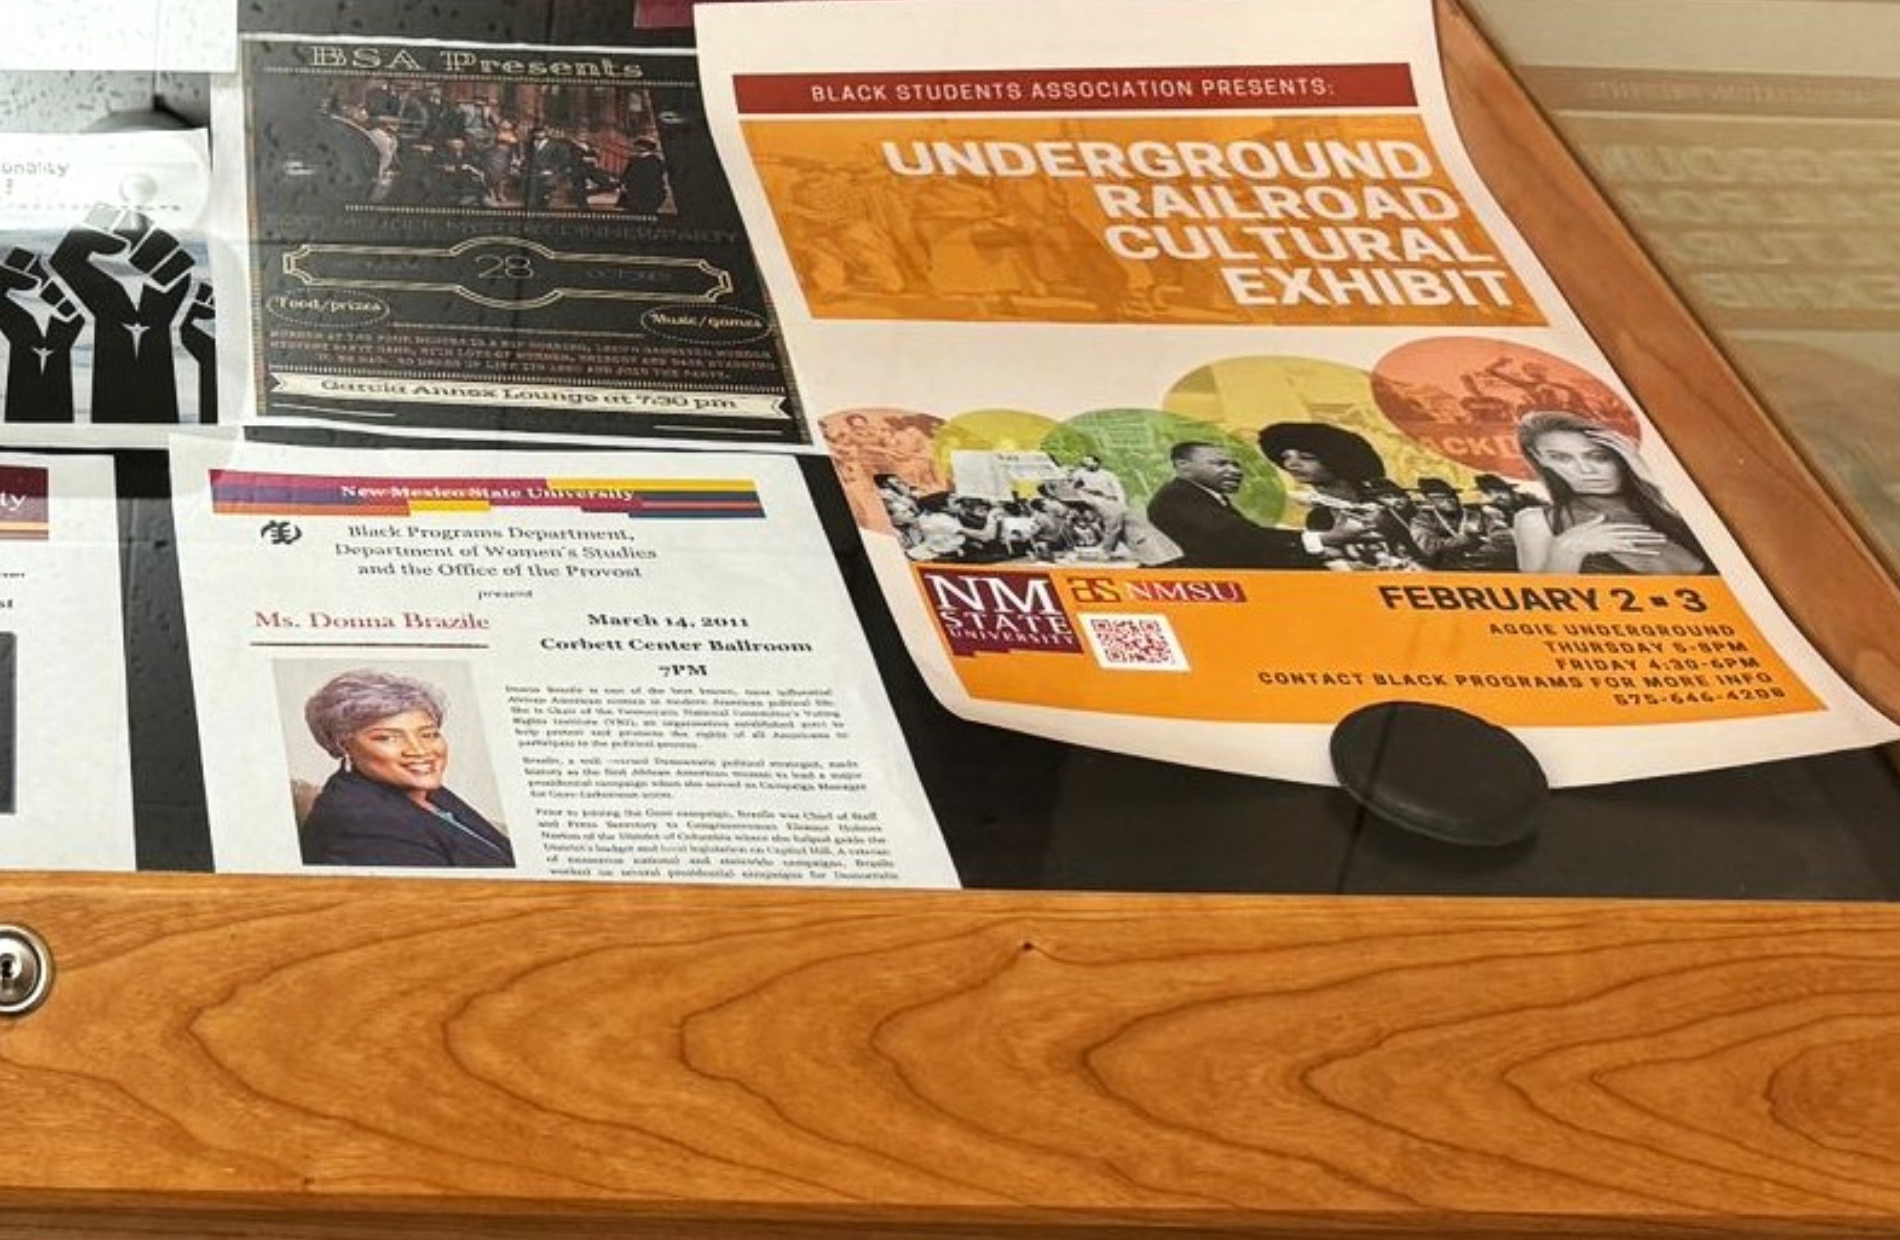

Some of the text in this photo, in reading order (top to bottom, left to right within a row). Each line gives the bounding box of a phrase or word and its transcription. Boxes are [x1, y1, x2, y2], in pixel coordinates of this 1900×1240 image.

[310, 47, 643, 79] BSA Presents
[811, 77, 1336, 103] BLACK STUDENTS ASSOCIATION PRESENTS:
[880, 140, 1434, 180] UNDERGROUND
[1094, 184, 1460, 222] RAILROAD
[1103, 224, 1498, 263] CULTURAL
[476, 256, 535, 282] 28
[1219, 267, 1514, 308] EXHIBIT
[414, 384, 494, 398] Annex
[502, 388, 592, 405] Lounge
[693, 398, 738, 413] pm
[348, 526, 635, 543] Black Programs Department,
[335, 545, 452, 559] Department
[459, 546, 478, 558] of
[583, 546, 656, 559] Studies
[923, 573, 1063, 615] NM
[1125, 582, 1239, 601] NMSU
[1378, 585, 1599, 612] FEBRUARY
[255, 613, 489, 629] Ms. Donna Brazile
[588, 614, 658, 627] March
[702, 616, 749, 628] 2011
[940, 611, 1071, 635] STATE
[951, 630, 1075, 645] UNIVERSITY
[1489, 624, 1735, 638] AGGIE UNDERGROUND
[540, 639, 813, 653] Corbett Center Ballroom
[1545, 640, 1665, 653] THURSDAY
[659, 665, 708, 676] 7PM
[1555, 657, 1760, 672] FRIDAY 4:30-6PM
[1259, 671, 1773, 689] CONTACT BLACK PROGRAMS FOR MORE INFO
[1615, 687, 1787, 706] 575-646-4208
